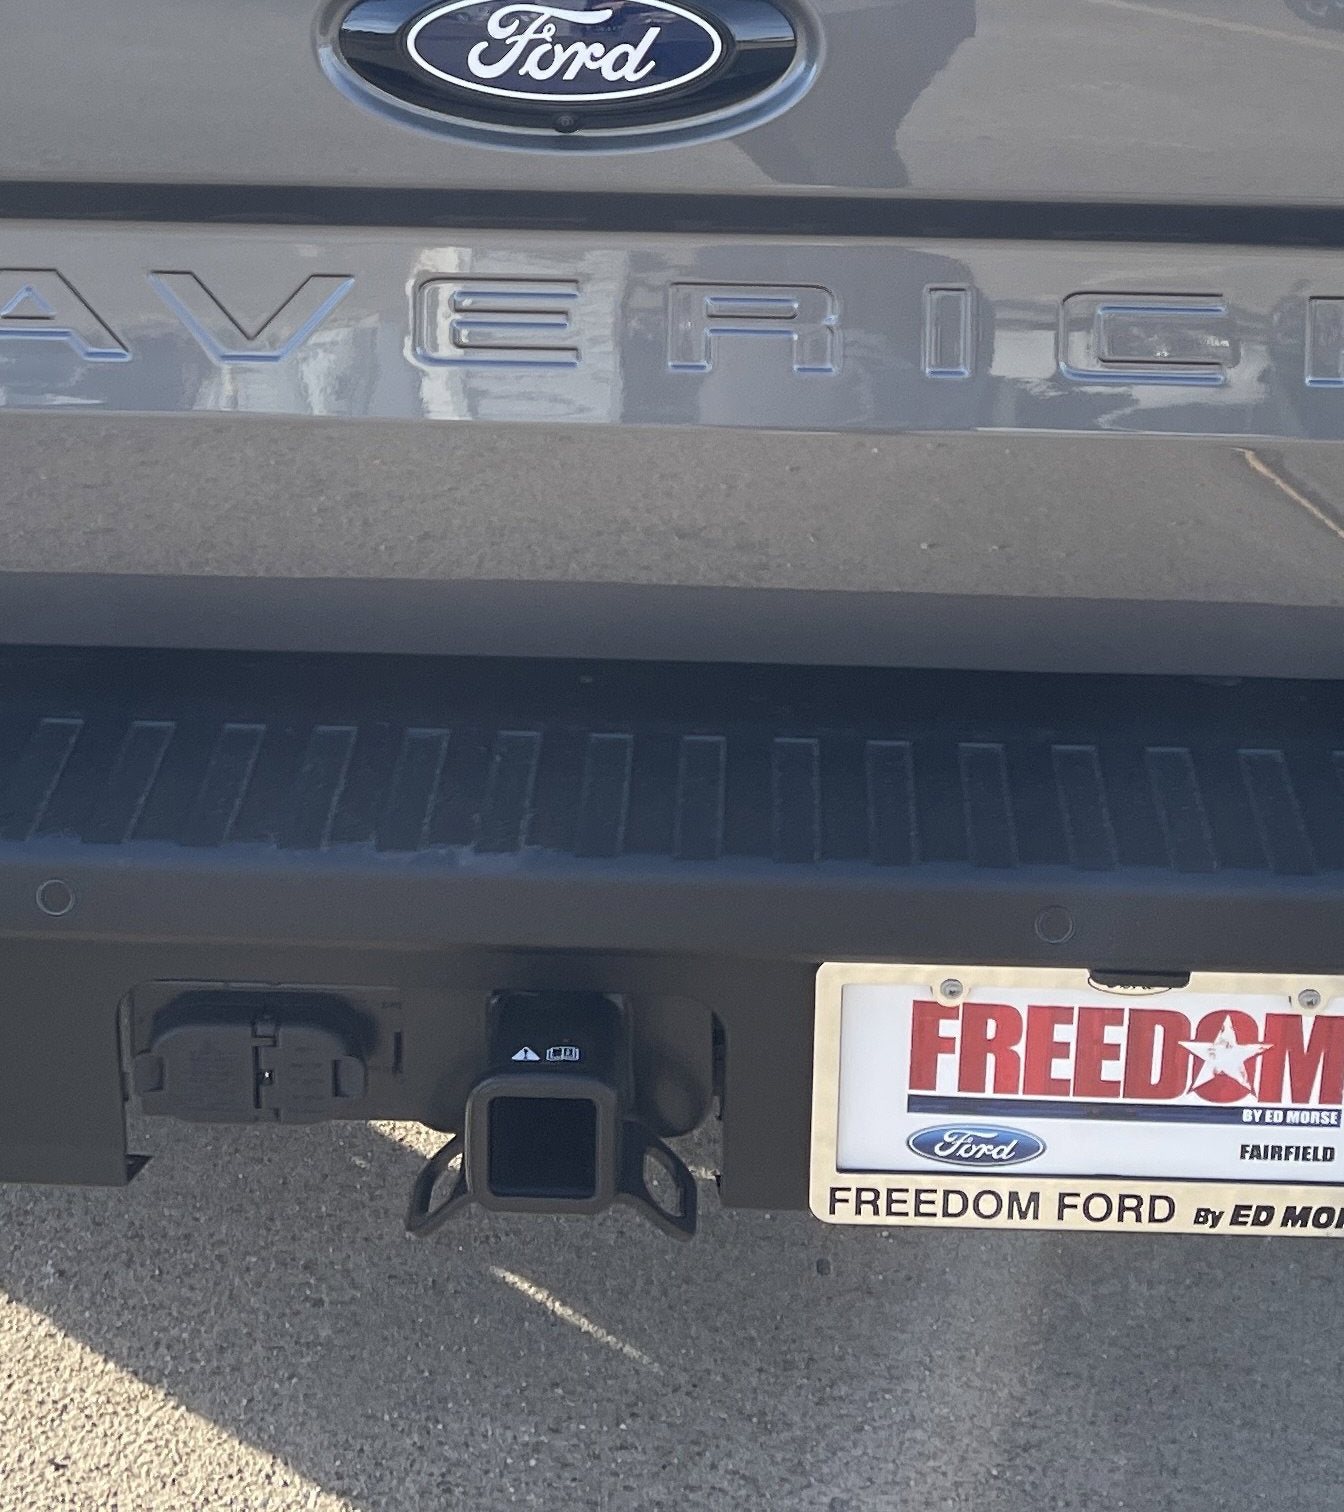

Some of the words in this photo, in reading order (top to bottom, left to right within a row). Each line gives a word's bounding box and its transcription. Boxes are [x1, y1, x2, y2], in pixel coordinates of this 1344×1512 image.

[467, 2, 662, 83] Ford
[1242, 1109, 1262, 1123] BY
[1264, 1110, 1284, 1124] ED
[1285, 1110, 1338, 1125] MORSE
[933, 1127, 1019, 1161] Ford
[1240, 1144, 1335, 1162] FAIRFIELD
[829, 1187, 1040, 1220] FREEDOM
[1057, 1192, 1176, 1223] FORD
[1193, 1207, 1224, 1229] By
[1229, 1204, 1275, 1227] ED
